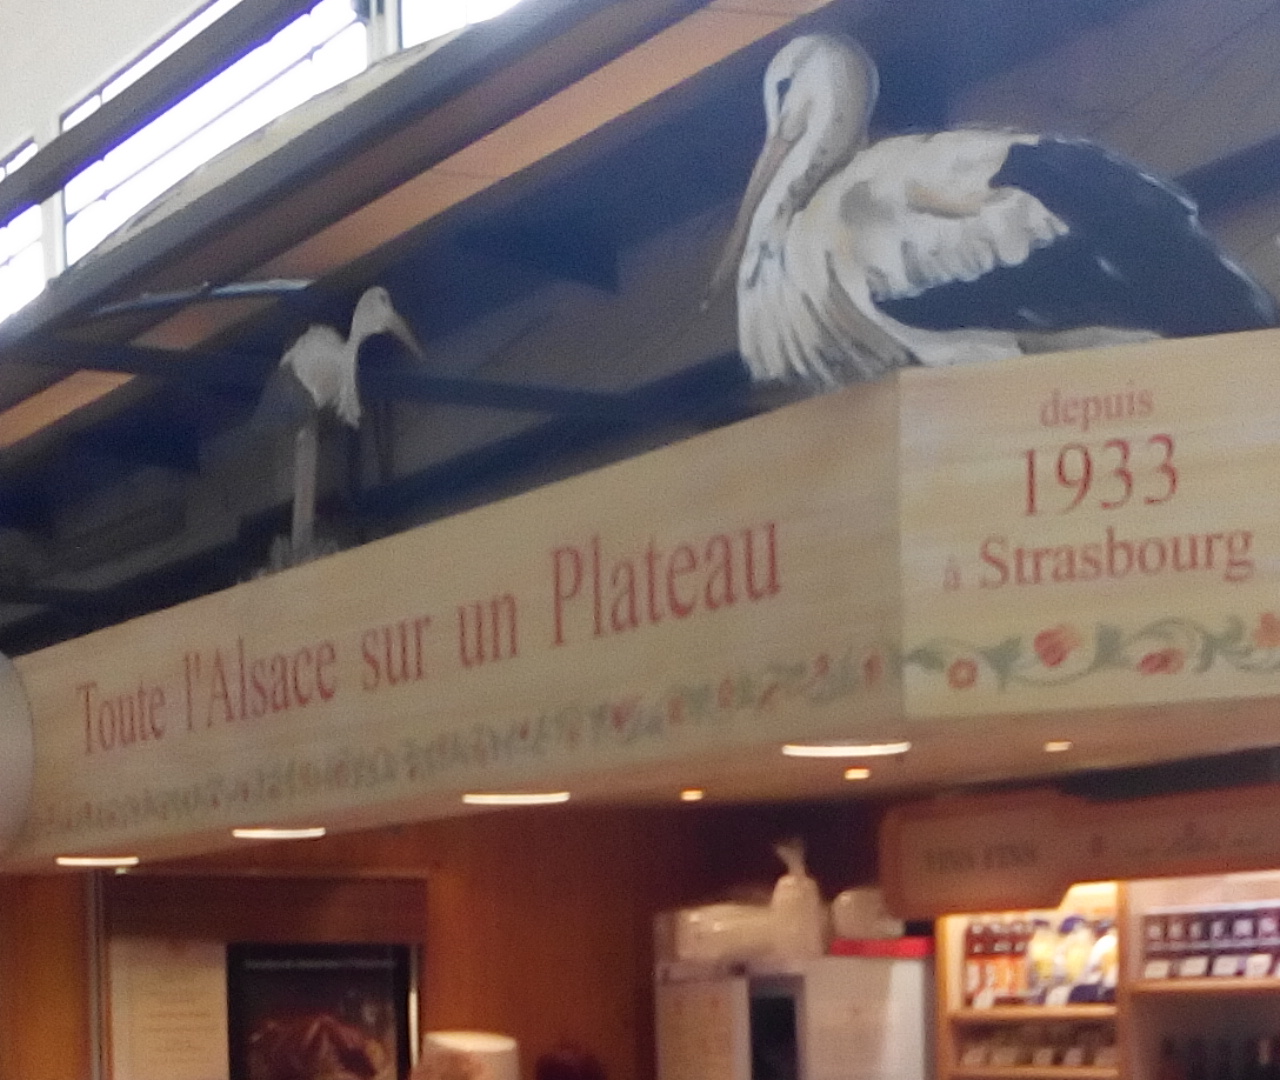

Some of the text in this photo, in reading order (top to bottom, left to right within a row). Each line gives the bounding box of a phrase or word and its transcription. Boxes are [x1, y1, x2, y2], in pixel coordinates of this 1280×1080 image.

[1039, 381, 1156, 431] depuis
[1025, 433, 1180, 517] 1933
[942, 526, 1256, 592] à Strasbourg
[76, 520, 782, 756] Toute l'Alsace sur un Plateau
